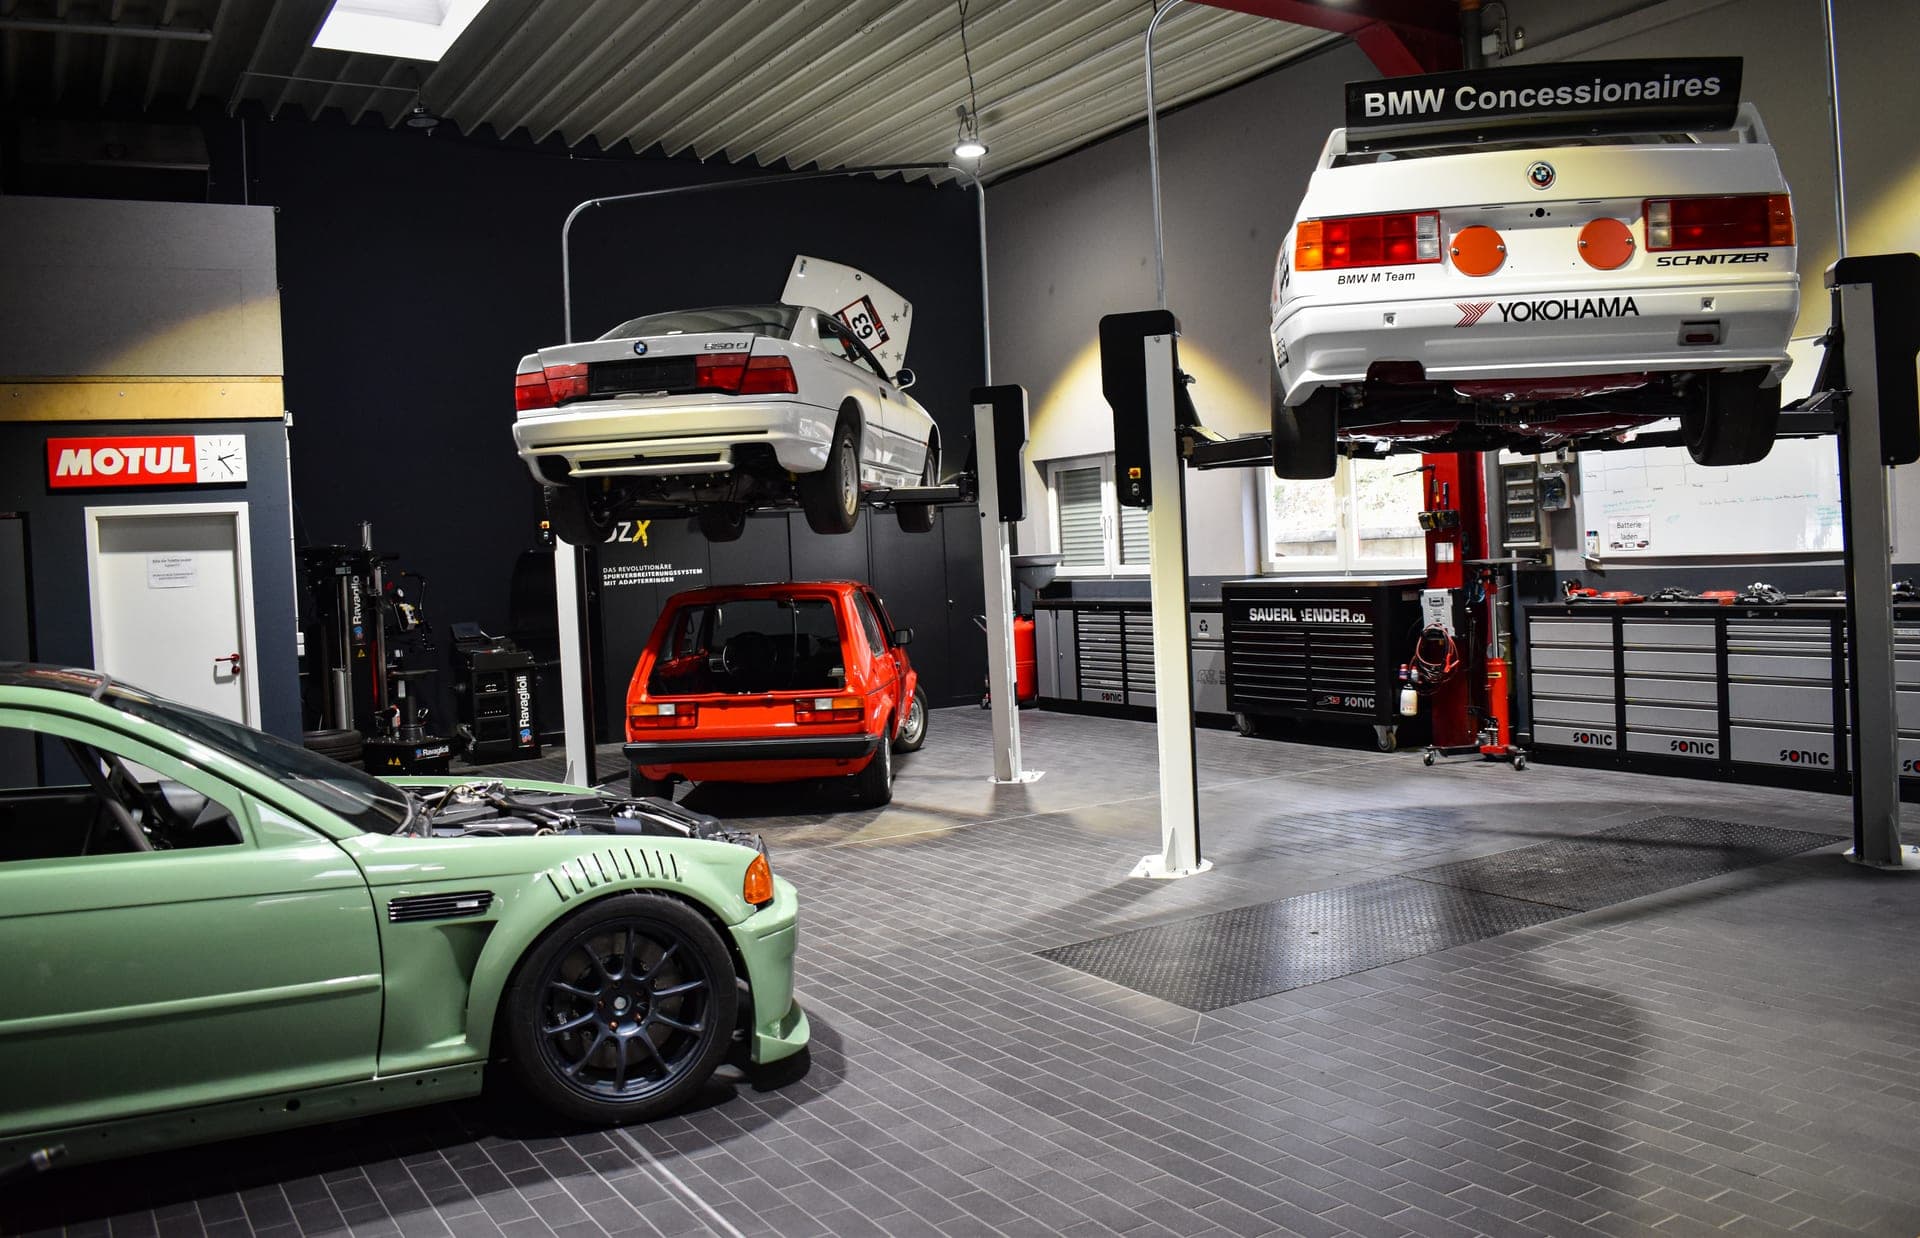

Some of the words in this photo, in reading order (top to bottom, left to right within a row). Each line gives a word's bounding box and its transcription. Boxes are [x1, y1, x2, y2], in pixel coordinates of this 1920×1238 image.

[1364, 88, 1445, 118] BMW
[1454, 74, 1721, 113] Concessionaires
[1656, 252, 1769, 267] SCHNITZER
[1337, 273, 1368, 285] BMW
[1371, 272, 1381, 282] M
[1385, 271, 1416, 282] Team
[1497, 296, 1640, 322] YOKOHAMA
[851, 312, 873, 340] 63
[56, 446, 192, 477] MOTUL
[1616, 520, 1642, 529] Batterie
[1620, 532, 1638, 541] laden
[603, 568, 703, 580] SPURVERBREITERUNGSSYSTEM
[618, 563, 672, 573] REVOLUTIONÄRE
[618, 577, 675, 585] ADAPTERRINGEN
[516, 675, 531, 728] Ravaglioli
